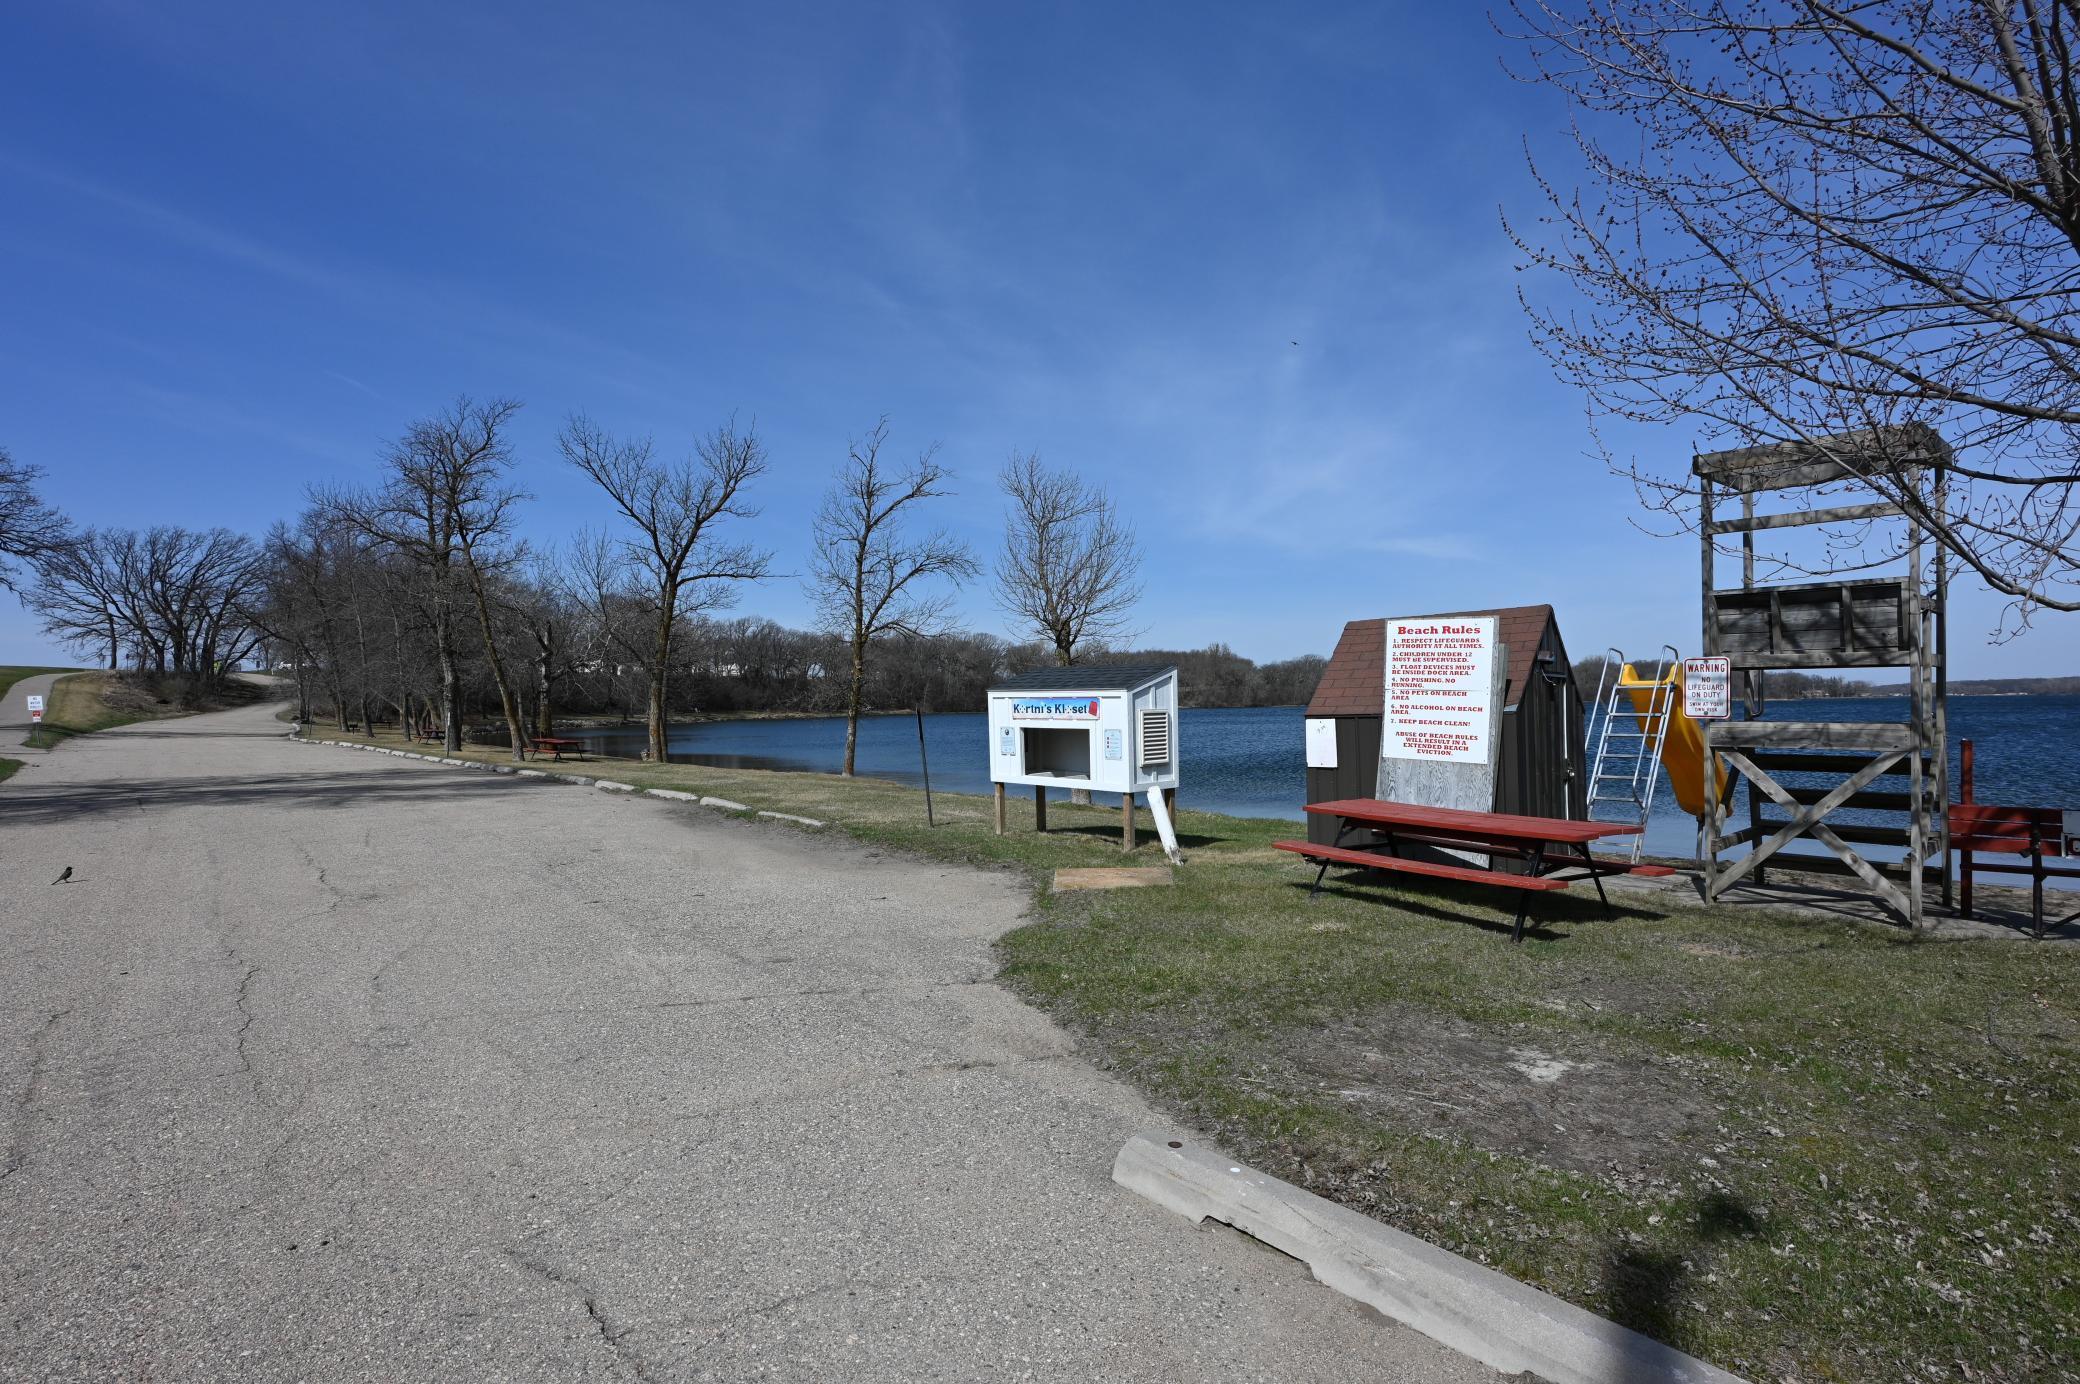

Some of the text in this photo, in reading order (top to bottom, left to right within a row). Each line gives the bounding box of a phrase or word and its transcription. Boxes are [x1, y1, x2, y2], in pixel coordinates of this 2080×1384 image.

[1398, 626, 1481, 634] Beach Rules
[1688, 664, 1725, 672] WARNING
